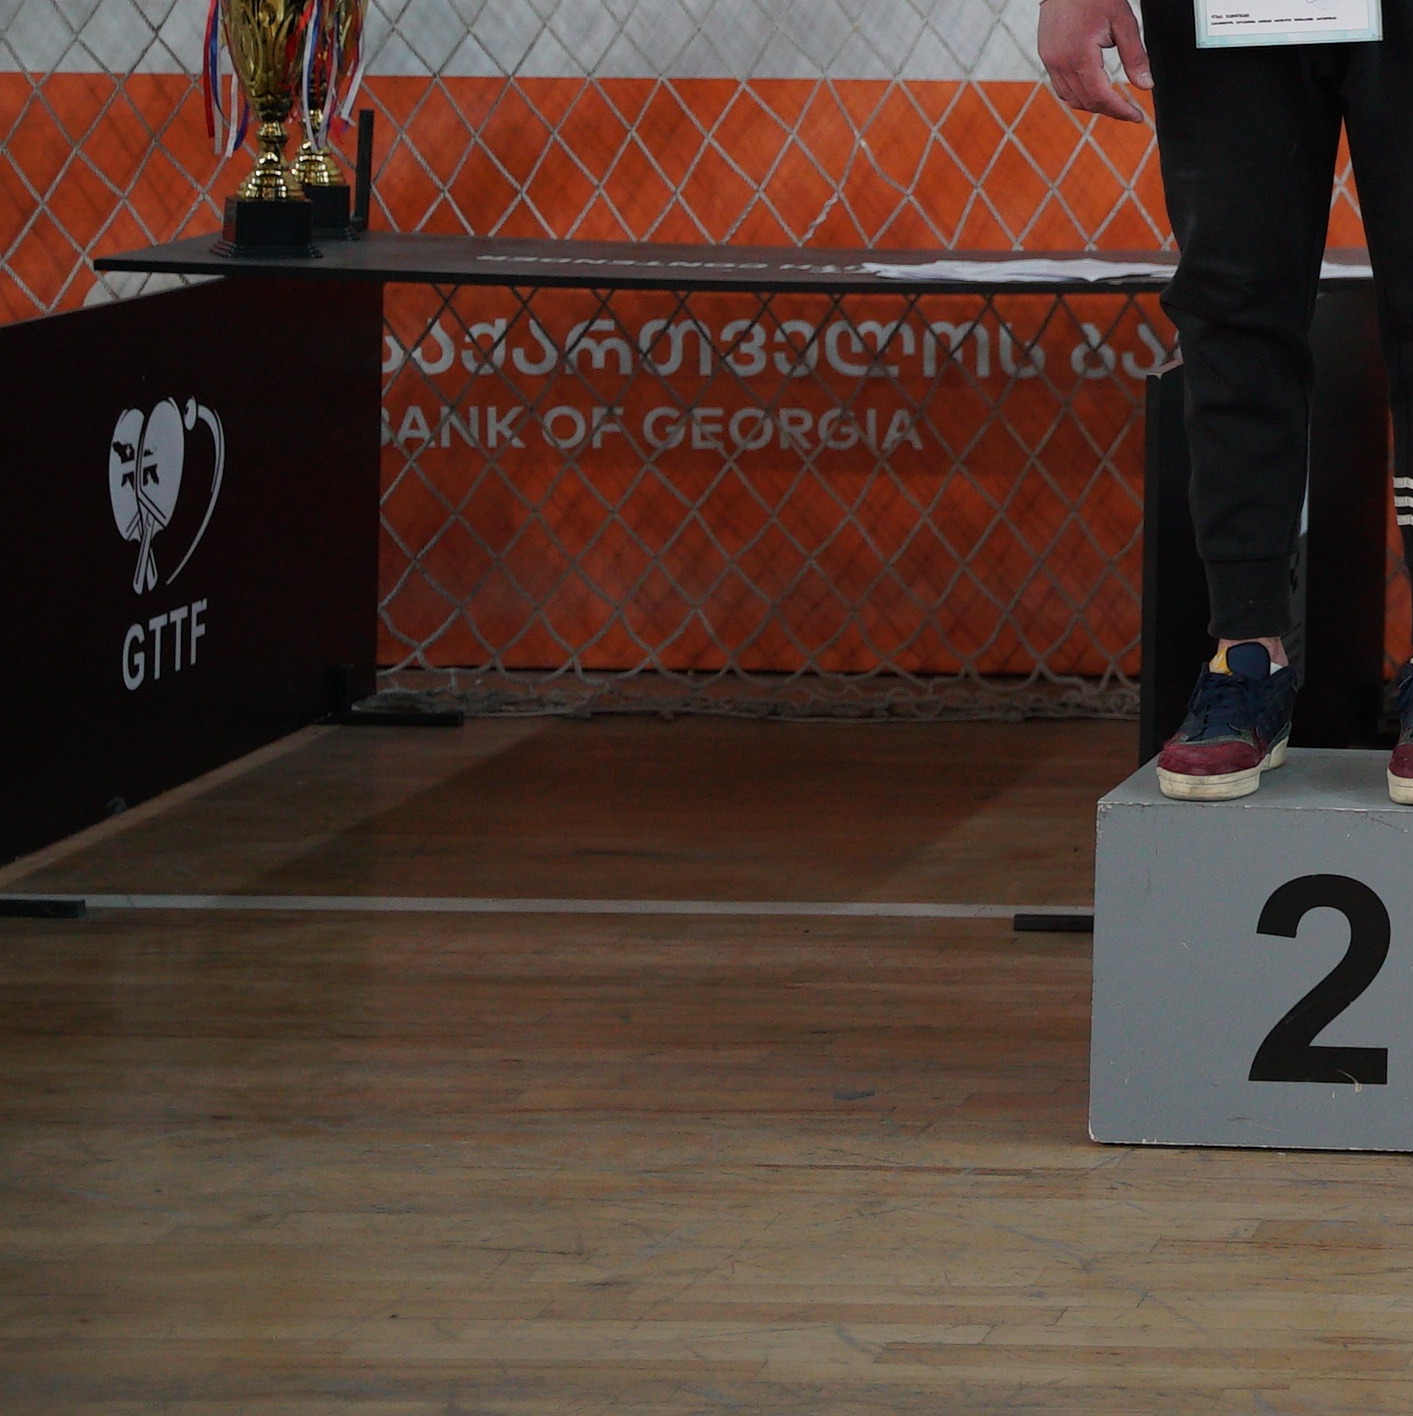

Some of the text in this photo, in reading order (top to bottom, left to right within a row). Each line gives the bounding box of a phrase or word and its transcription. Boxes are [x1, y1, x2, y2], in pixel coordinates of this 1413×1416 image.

[1070, 322, 1184, 381] ბა
[541, 405, 625, 451] OF
[642, 406, 924, 452] GEORGIA
[121, 597, 208, 691] GTTF
[1246, 873, 1392, 1086] 2
